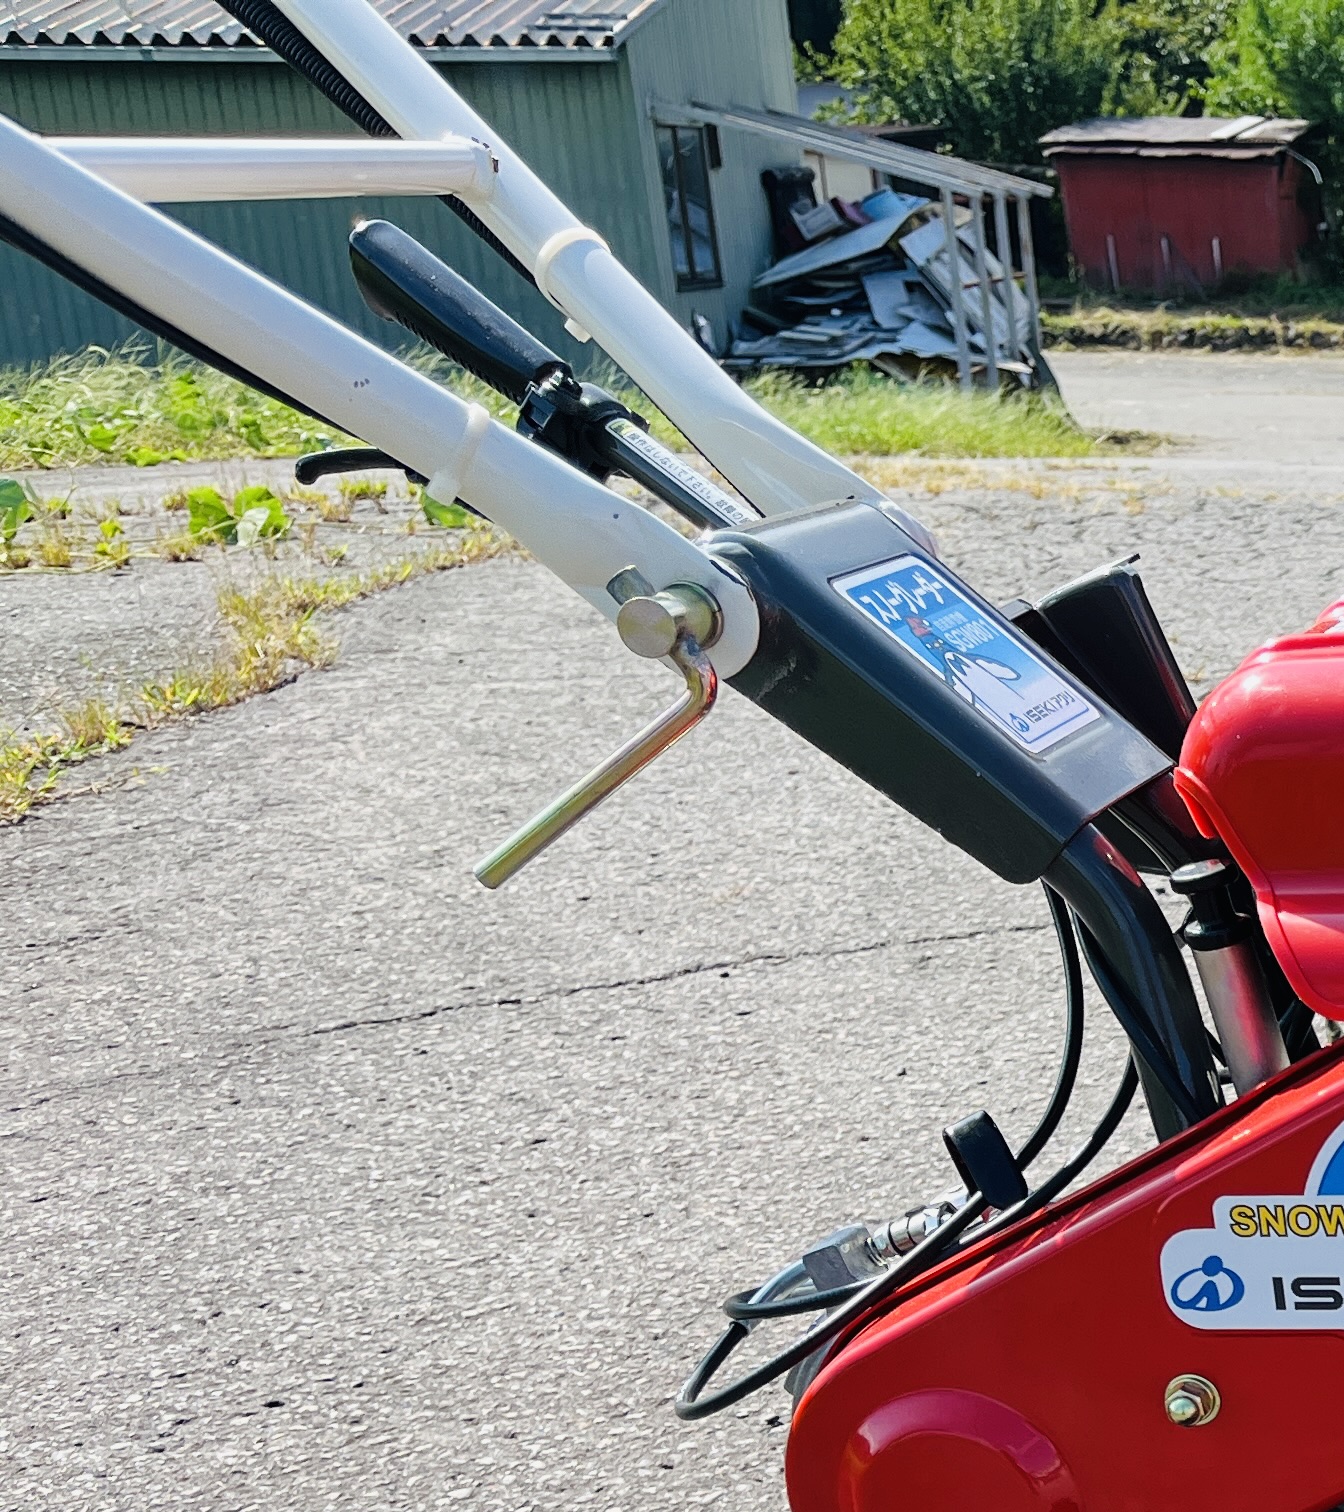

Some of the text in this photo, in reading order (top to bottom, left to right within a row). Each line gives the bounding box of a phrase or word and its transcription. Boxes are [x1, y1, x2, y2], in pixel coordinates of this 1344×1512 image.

[859, 571, 944, 625] スノーグレーダー
[943, 618, 1000, 652] SGW801
